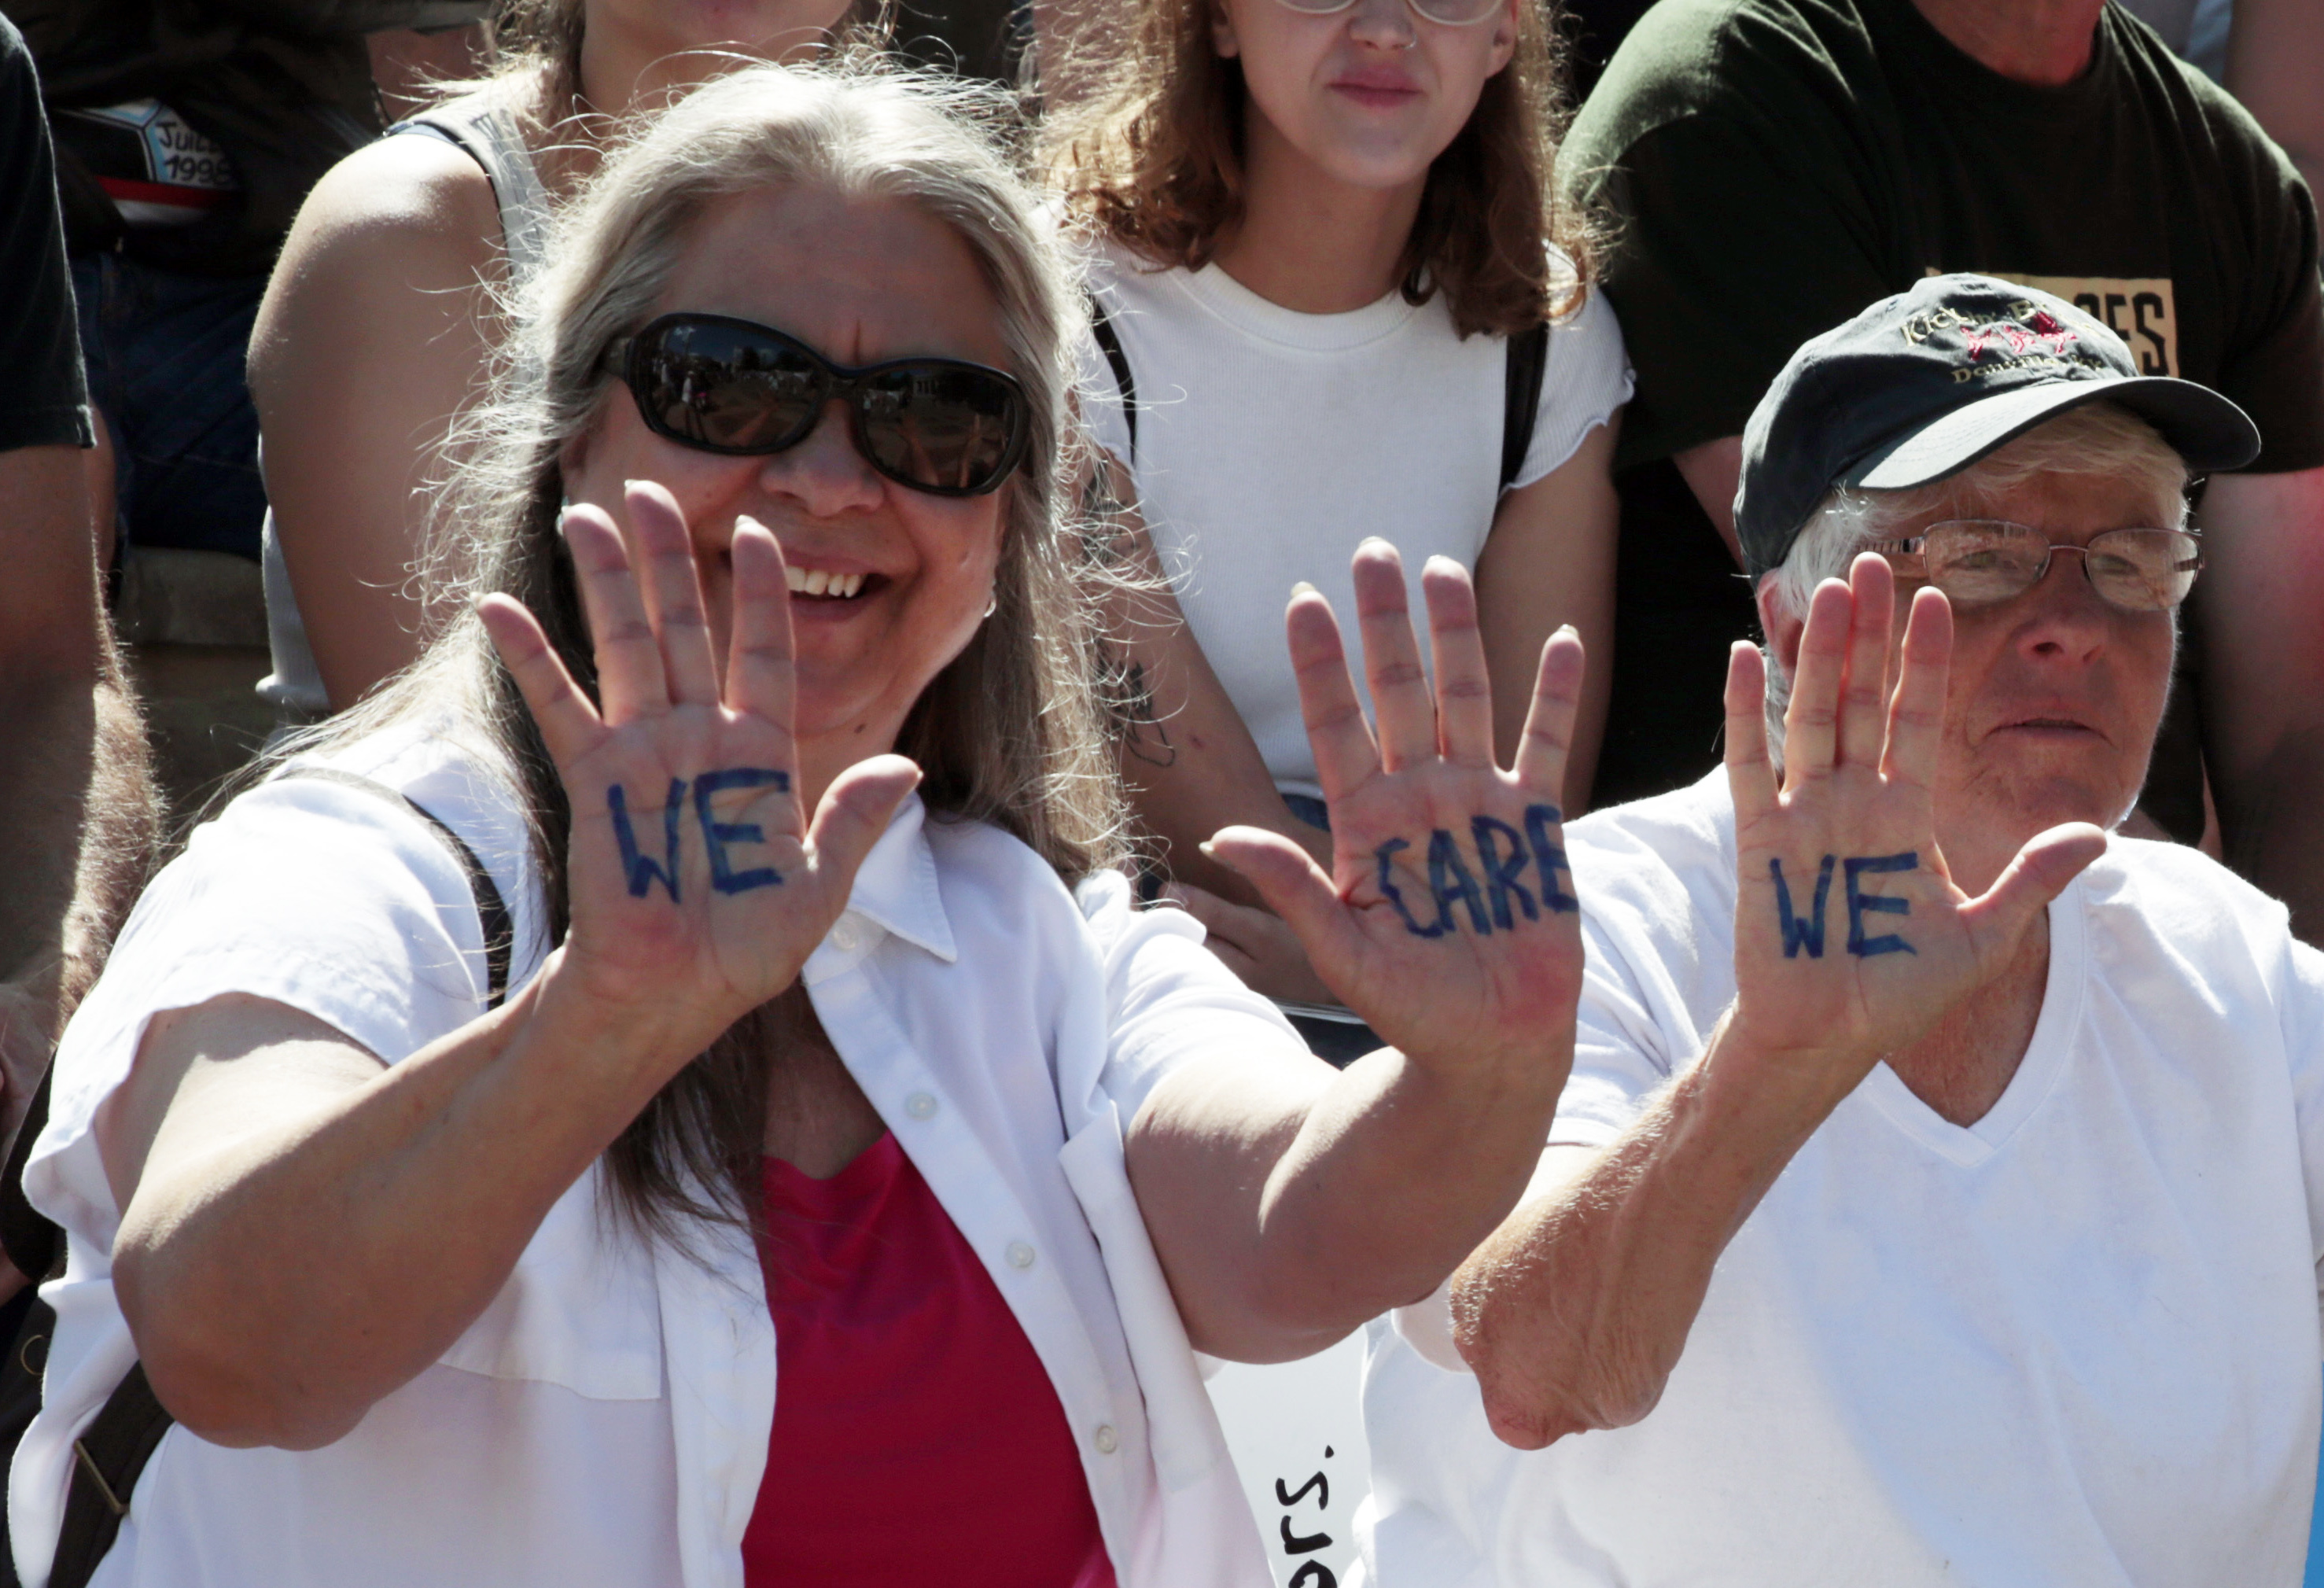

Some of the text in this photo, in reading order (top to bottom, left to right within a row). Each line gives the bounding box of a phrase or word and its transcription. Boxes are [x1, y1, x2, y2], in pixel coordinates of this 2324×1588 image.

[607, 768, 790, 905] WE
[1375, 804, 1579, 938] CARE
[1770, 850, 1918, 958] WE
